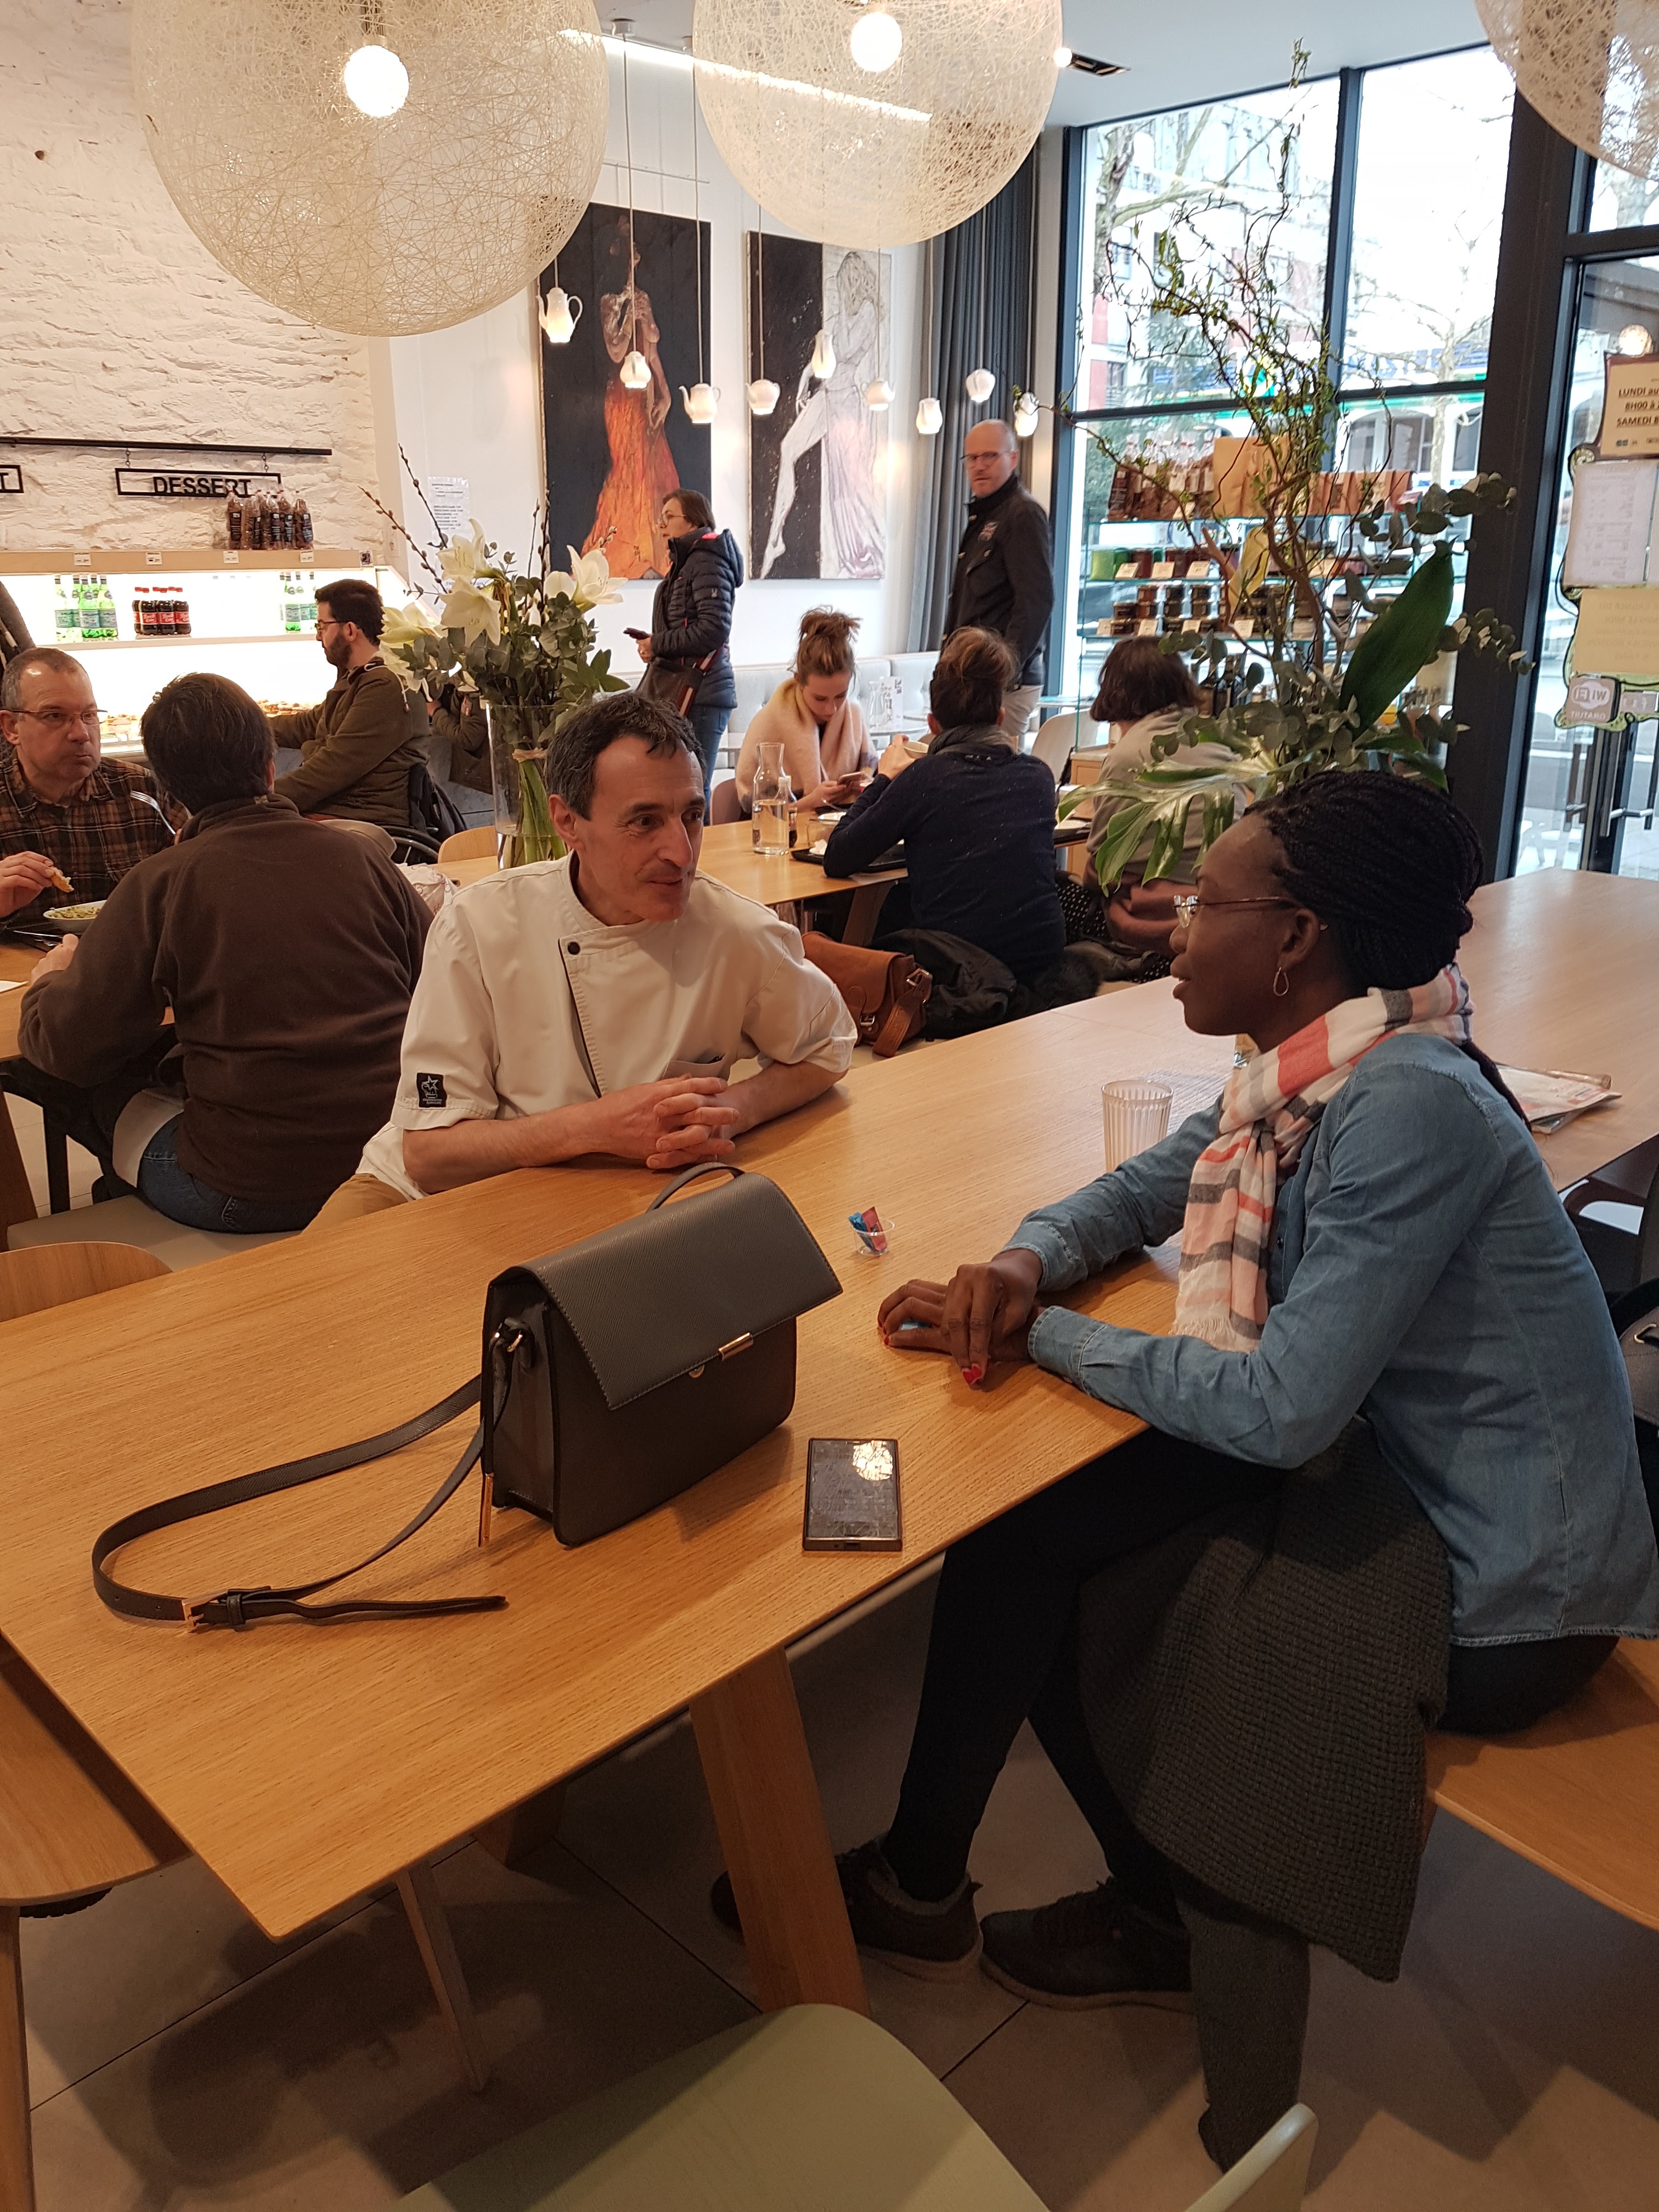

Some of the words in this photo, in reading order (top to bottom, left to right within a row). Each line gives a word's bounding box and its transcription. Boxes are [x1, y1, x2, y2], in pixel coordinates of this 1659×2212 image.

[1618, 387, 1646, 397] LUNDI
[1617, 416, 1652, 426] SAMEDI
[153, 476, 251, 498] DESSERT
